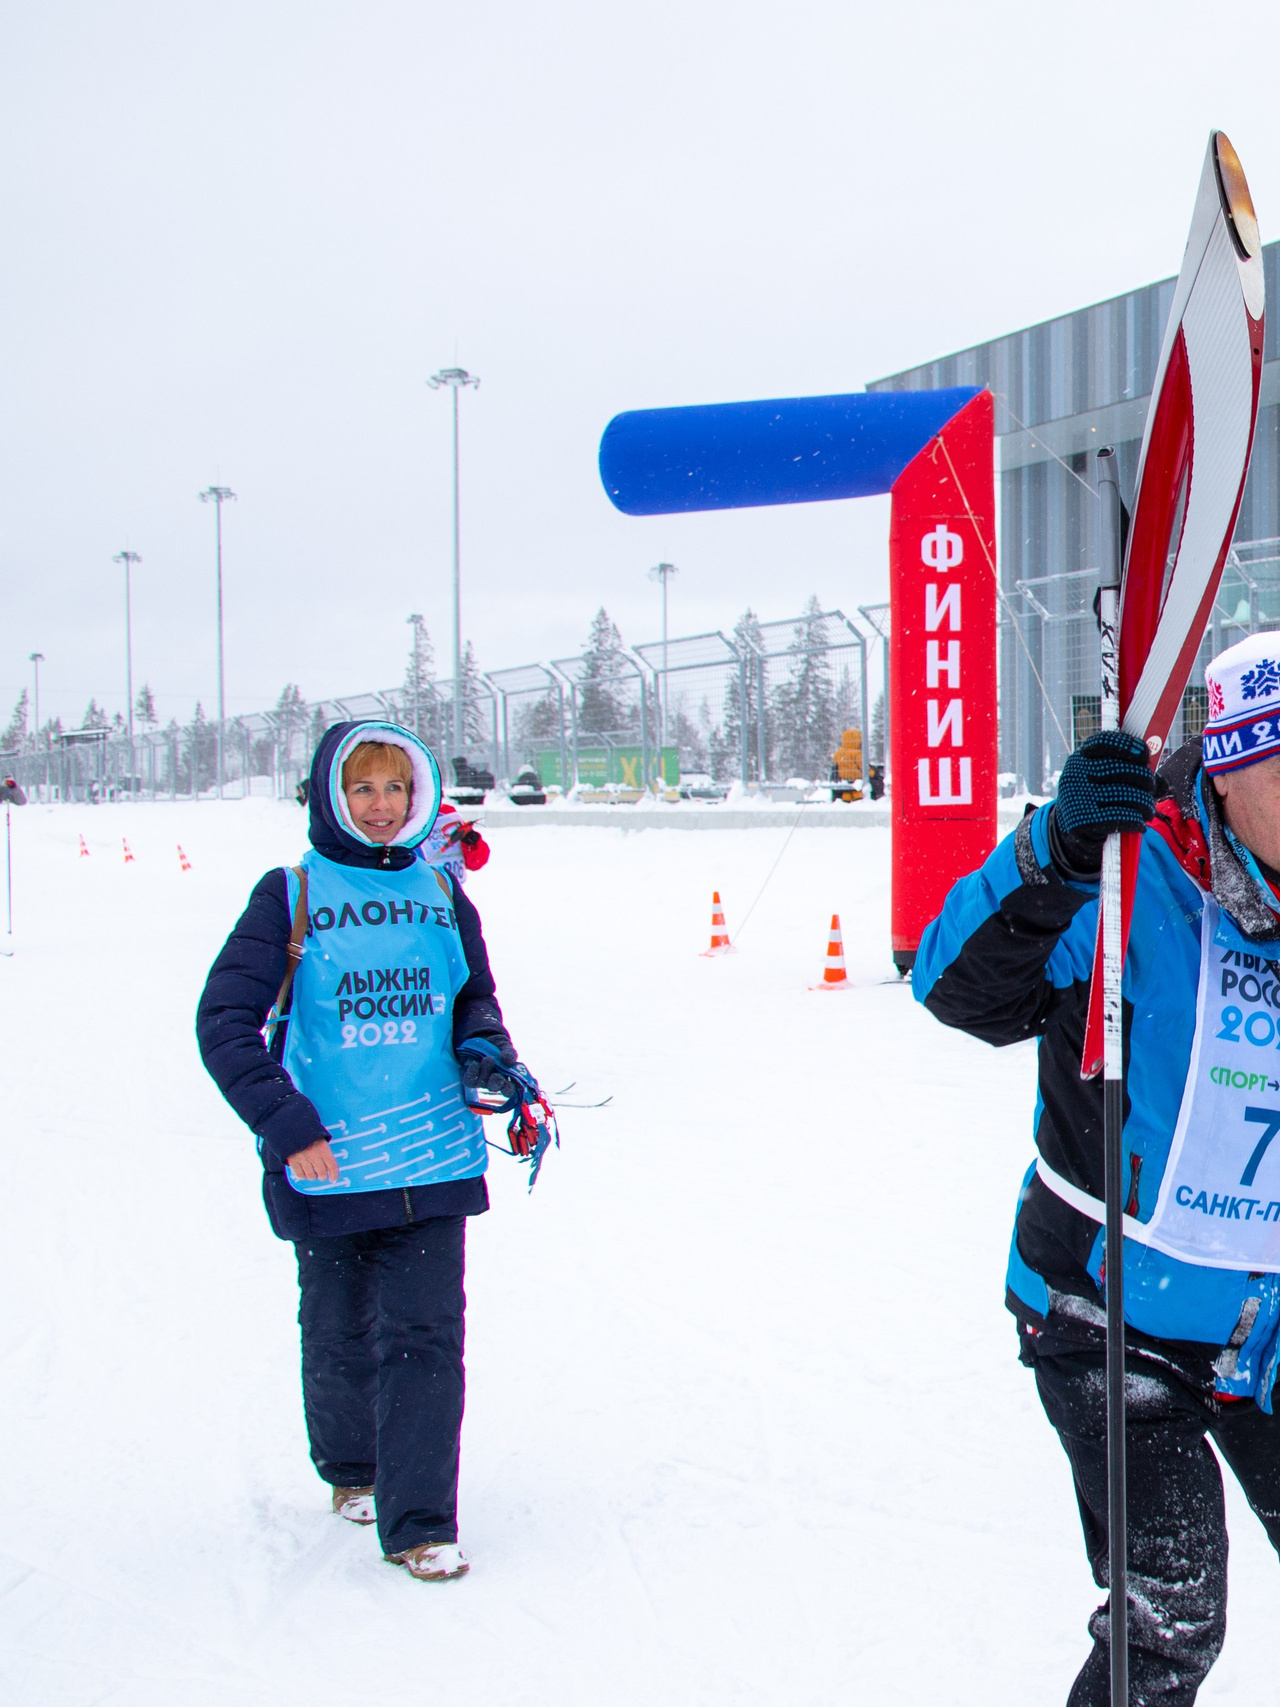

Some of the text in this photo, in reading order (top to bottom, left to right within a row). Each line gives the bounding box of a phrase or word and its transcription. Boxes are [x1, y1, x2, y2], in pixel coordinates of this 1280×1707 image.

[918, 524, 972, 806] ФИНИШ
[308, 900, 458, 938] ОЛОНТЕ
[335, 967, 430, 996] ЛЫЖНЯ
[339, 993, 434, 1022] РОССИИ
[341, 1020, 418, 1049] 2022
[1210, 1066, 1268, 1092] СПОРТ
